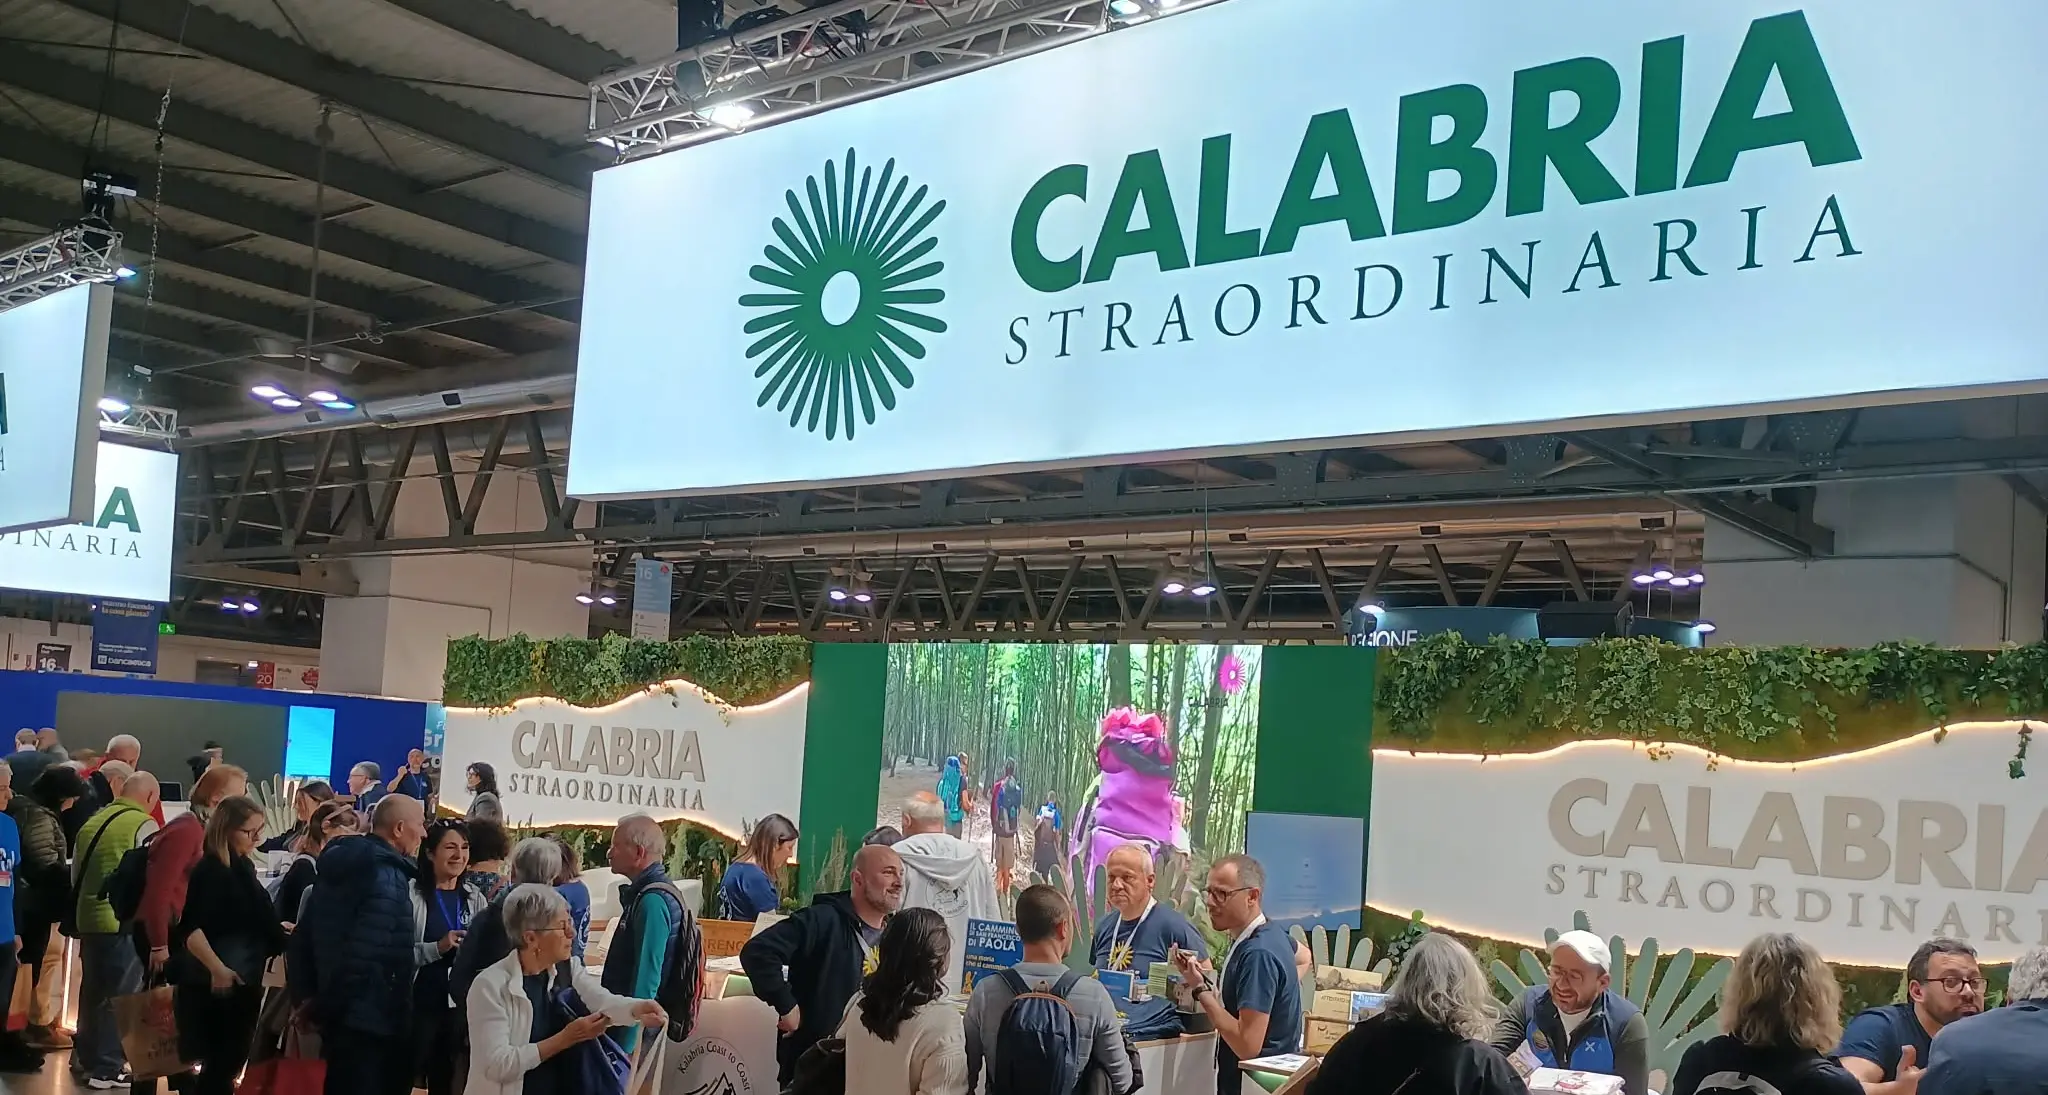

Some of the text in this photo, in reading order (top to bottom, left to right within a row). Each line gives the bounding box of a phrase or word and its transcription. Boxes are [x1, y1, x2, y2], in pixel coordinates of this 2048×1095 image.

[1010, 9, 1863, 293] CALABRIA
[1004, 193, 1863, 365] STRAORDINARIA
[639, 567, 653, 580] 16
[40, 657, 57, 672] 16
[256, 674, 273, 685] 20
[511, 720, 706, 783] CALABRIA
[508, 772, 706, 812] STRAORDINARIA
[969, 922, 977, 931] IL
[967, 937, 1016, 952] DI PAOLA
[987, 932, 1021, 942] FRANCESCO
[678, 1040, 751, 1091] Kalabria Coast to Coast
